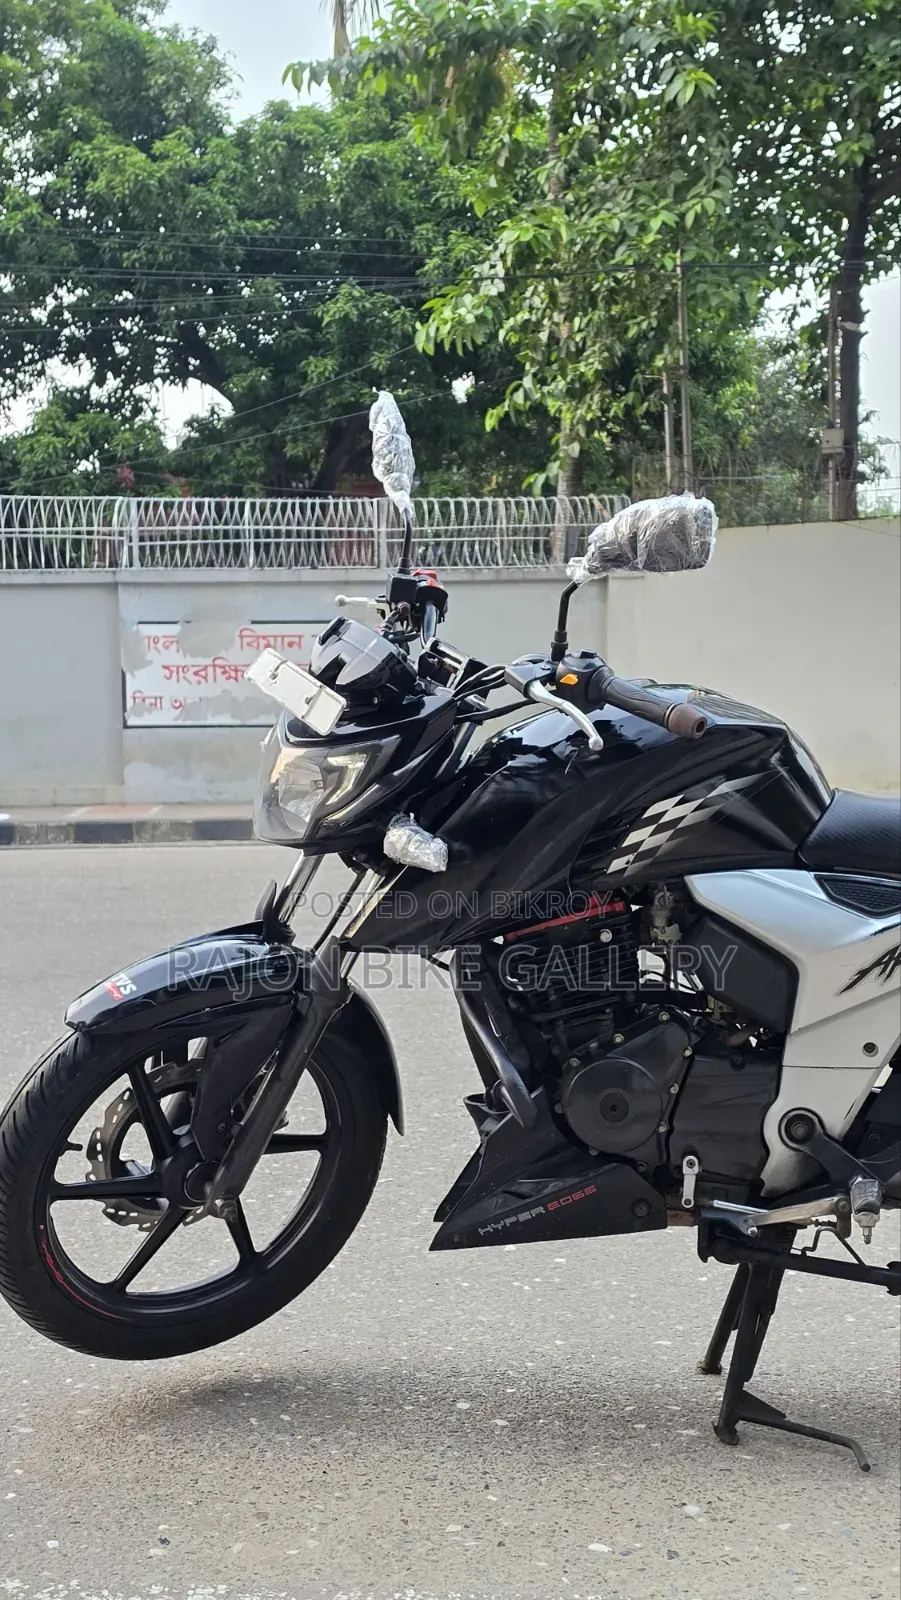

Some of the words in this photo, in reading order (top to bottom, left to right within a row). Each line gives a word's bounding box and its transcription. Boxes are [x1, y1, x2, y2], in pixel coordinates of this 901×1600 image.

[237, 627, 304, 652] বিমান
[161, 656, 250, 685] সংরক্ষি
[478, 1206, 546, 1236] HYPER
[547, 1185, 598, 1211] EDGE
